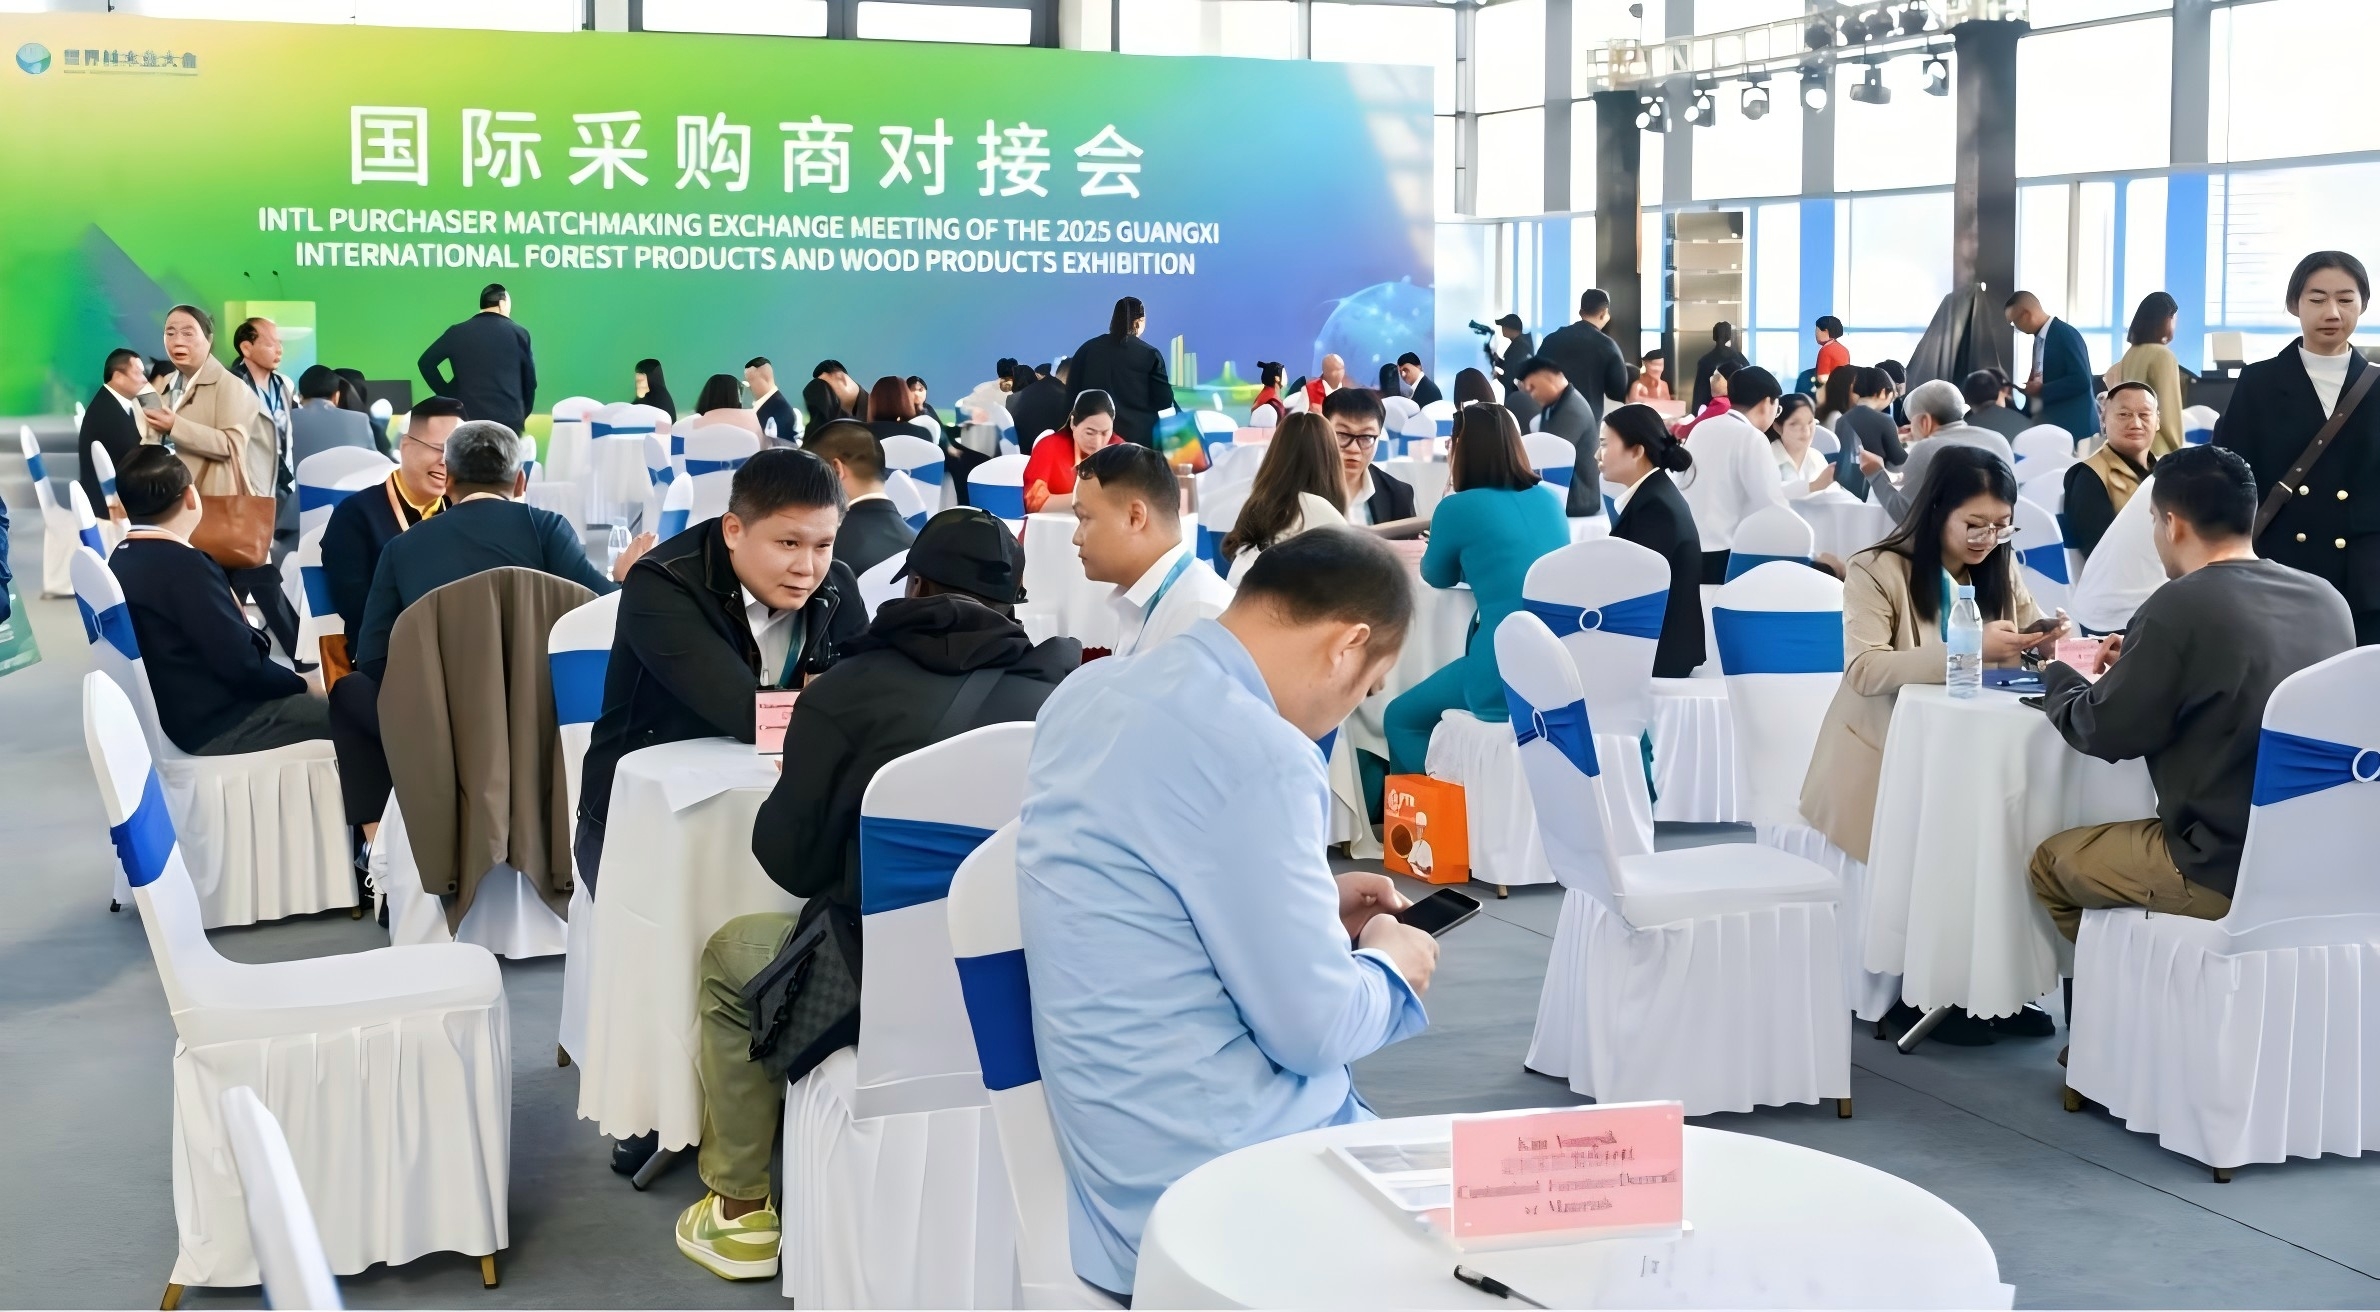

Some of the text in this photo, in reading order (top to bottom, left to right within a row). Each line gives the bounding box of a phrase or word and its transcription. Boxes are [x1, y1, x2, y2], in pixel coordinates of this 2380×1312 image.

[350, 105, 1144, 199] 国际采购商对接会
[259, 207, 1219, 244] INTL PURCHASER MATCHMAKING EXCHANGE MEETING OF THE 2025 GUANGXI
[296, 242, 1195, 275] INTERNATIONAL FOREST PRODUCTS AND WOOD PRODUCTS EXHIBITION
